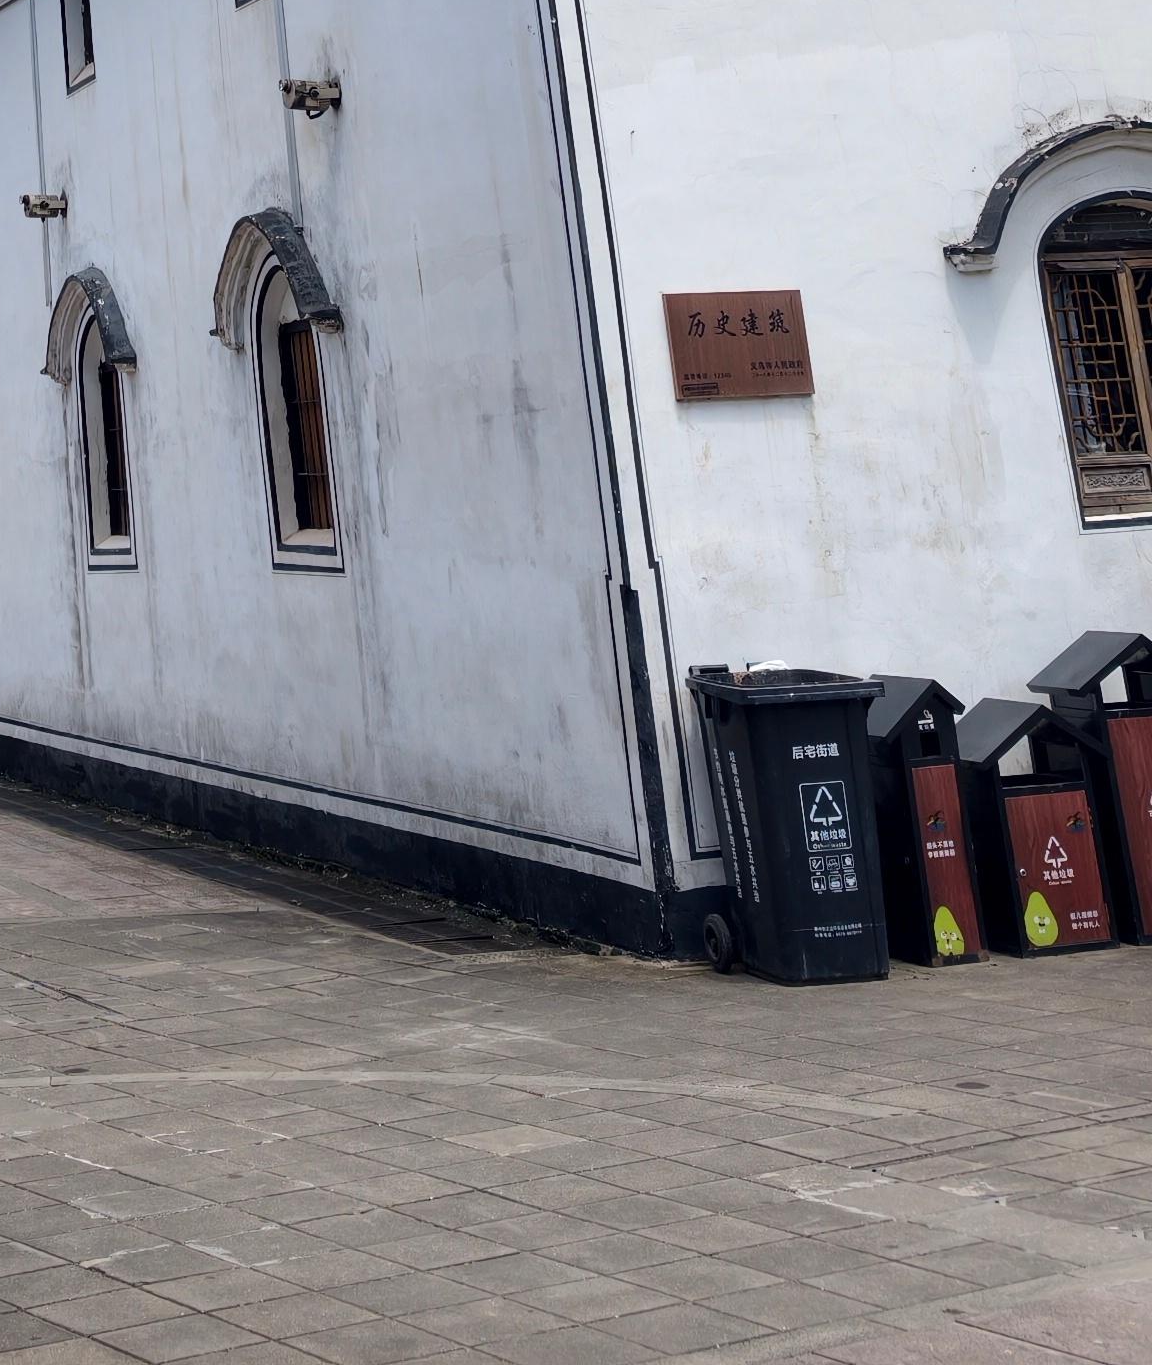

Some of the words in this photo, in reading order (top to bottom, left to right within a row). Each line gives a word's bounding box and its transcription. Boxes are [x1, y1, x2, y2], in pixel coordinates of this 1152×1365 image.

[687, 309, 790, 338] 历史建筑
[792, 743, 840, 759] 后宅街道
[810, 828, 847, 842] 其他垃圾
[1042, 868, 1075, 881] 其他垃圾
